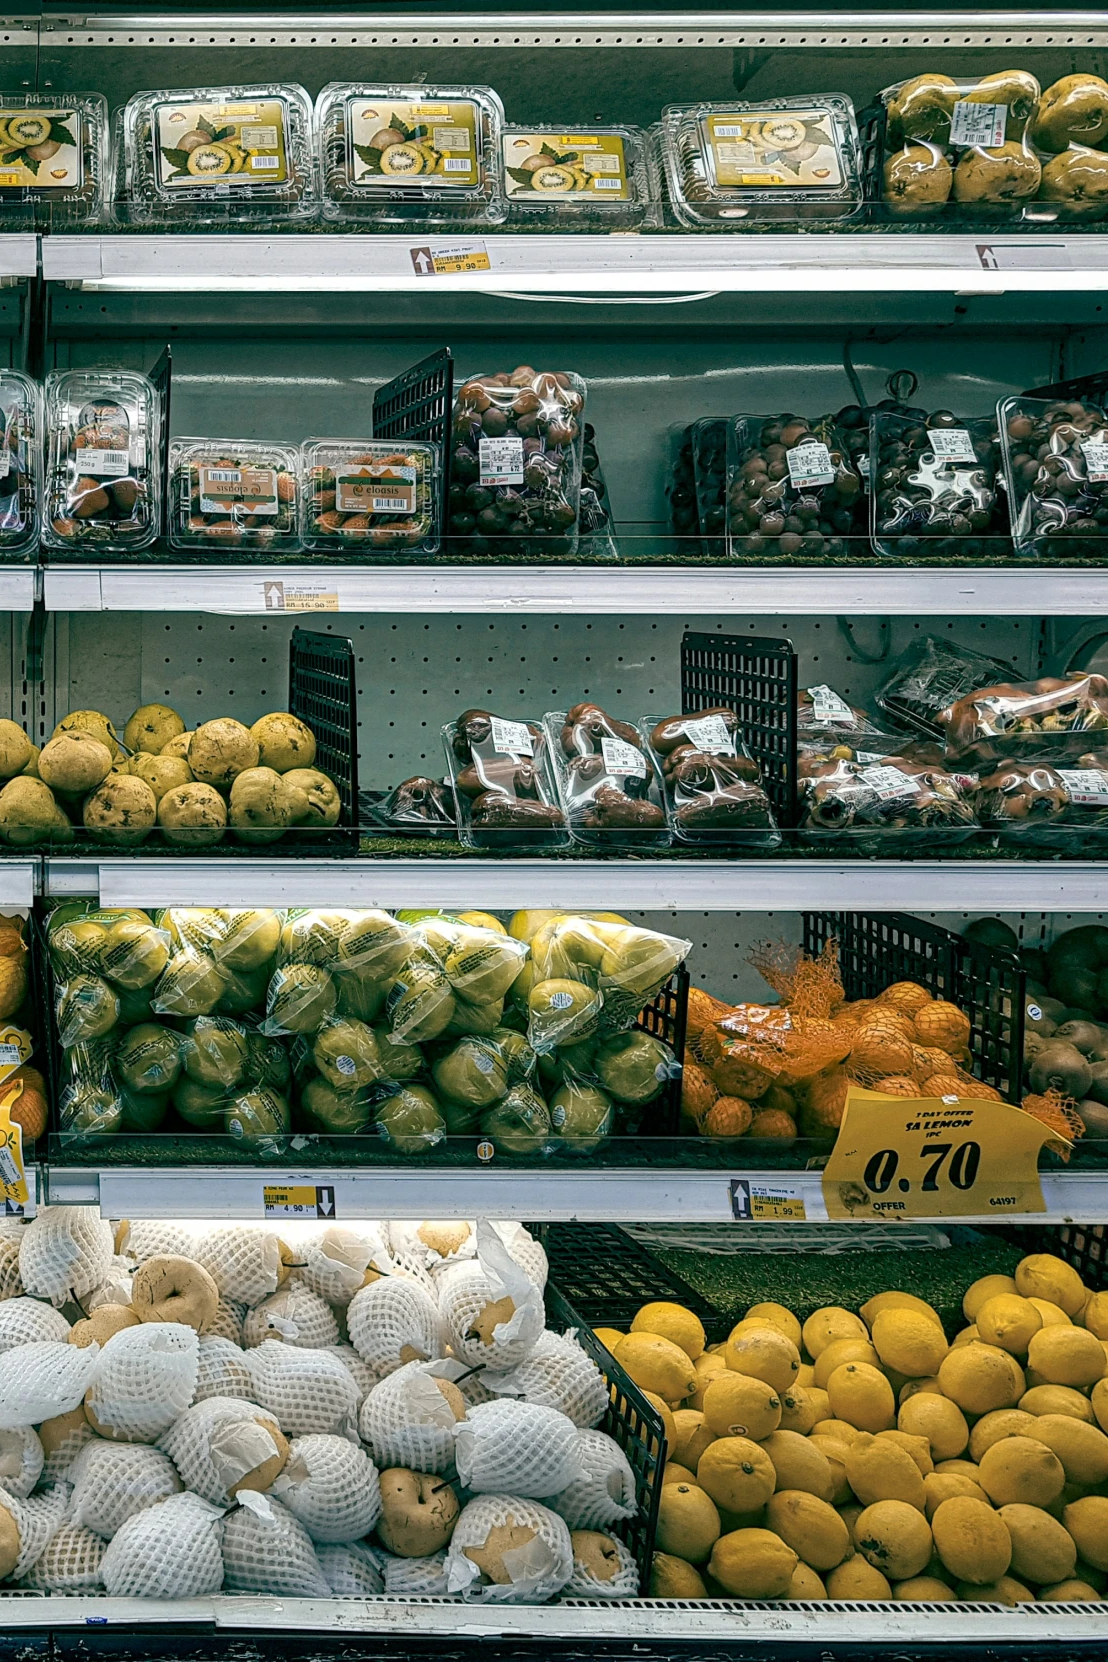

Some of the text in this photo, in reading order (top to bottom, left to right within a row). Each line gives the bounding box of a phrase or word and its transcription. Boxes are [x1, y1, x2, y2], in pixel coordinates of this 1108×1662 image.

[456, 263, 476, 271] 9.90
[366, 485, 399, 495] eloasis
[905, 1119, 974, 1131] SA LEMON
[863, 1141, 981, 1194] 0.70
[873, 1201, 906, 1211] OFFER
[989, 1197, 1017, 1206] 64197
[284, 1204, 303, 1212] 4.90
[774, 1206, 793, 1215] 1.99
